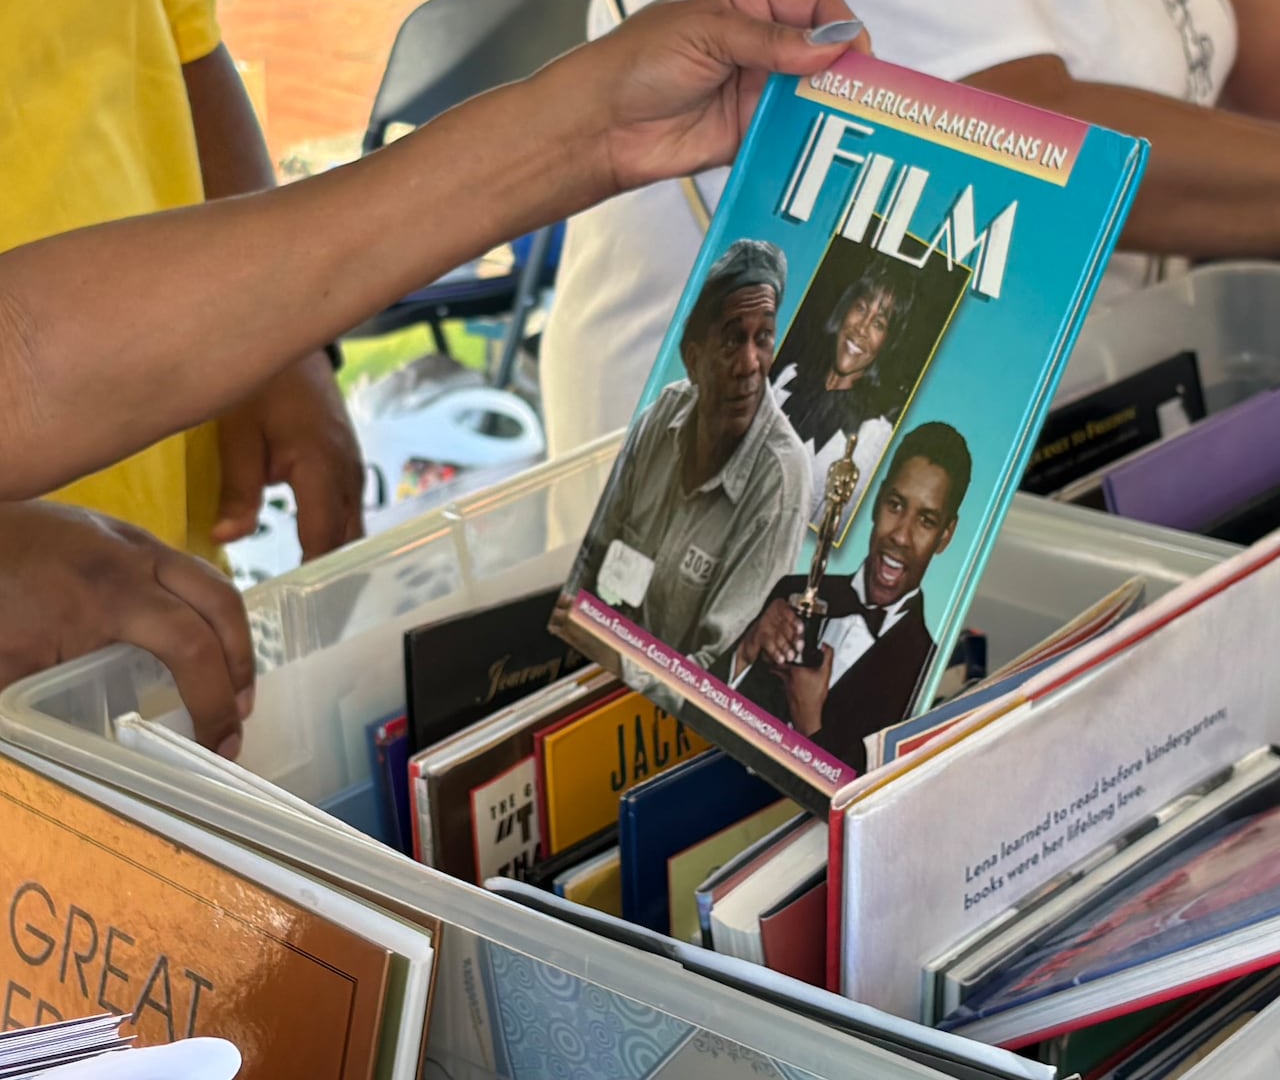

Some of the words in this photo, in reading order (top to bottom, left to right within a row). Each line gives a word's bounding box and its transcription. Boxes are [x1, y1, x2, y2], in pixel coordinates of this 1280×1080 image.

[808, 70, 864, 102] GREAT
[858, 86, 938, 128] AFRICAN
[933, 108, 1043, 162] AMERICANS
[1039, 141, 1069, 171] IN
[777, 111, 1019, 300] FILM
[683, 548, 714, 580] 302
[963, 875, 1005, 912] books
[1007, 852, 1040, 881] were
[1041, 834, 1066, 860] her
[1066, 802, 1117, 843] lifelong
[1117, 784, 1147, 810] love.
[964, 853, 999, 884] Lena
[1000, 811, 1051, 860] learned
[1053, 808, 1068, 825] to
[1070, 780, 1100, 815] read
[1101, 758, 1144, 794] before
[8, 880, 216, 1043] GREAT
